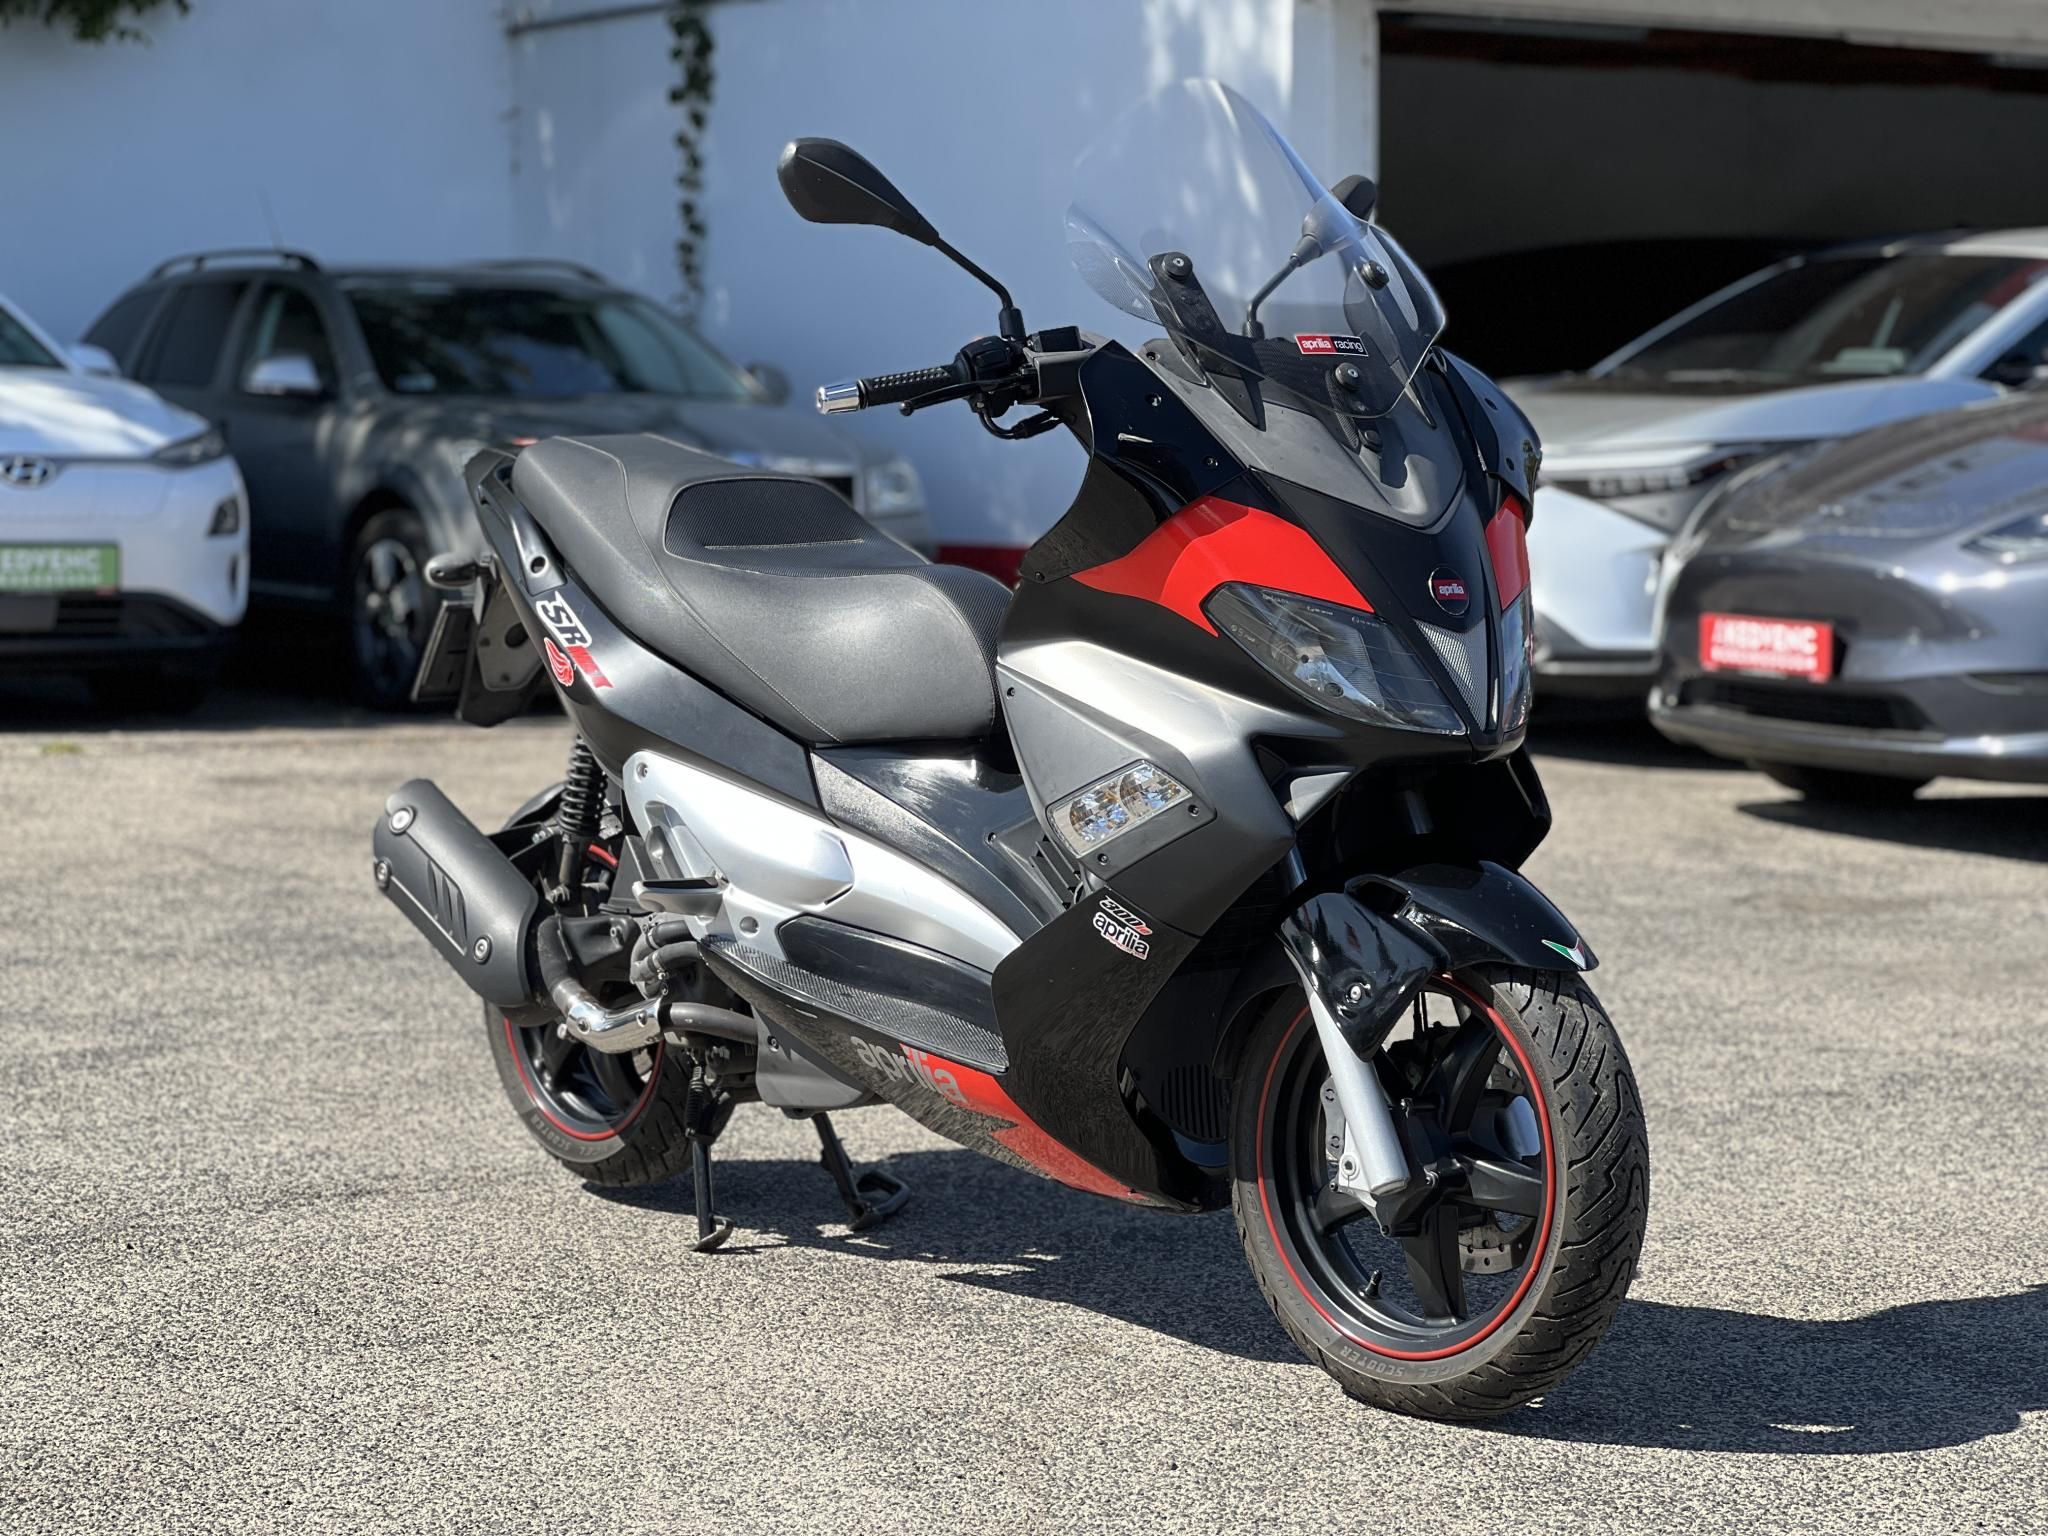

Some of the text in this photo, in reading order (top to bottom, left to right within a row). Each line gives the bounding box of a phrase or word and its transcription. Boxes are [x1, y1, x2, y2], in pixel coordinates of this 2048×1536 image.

[1301, 338, 1364, 353] aprilia racing
[1438, 583, 1465, 596] aprilia
[1094, 913, 1148, 956] aprilia
[851, 1036, 968, 1103] aprilia
[1339, 1344, 1406, 1377] SCOOTER
